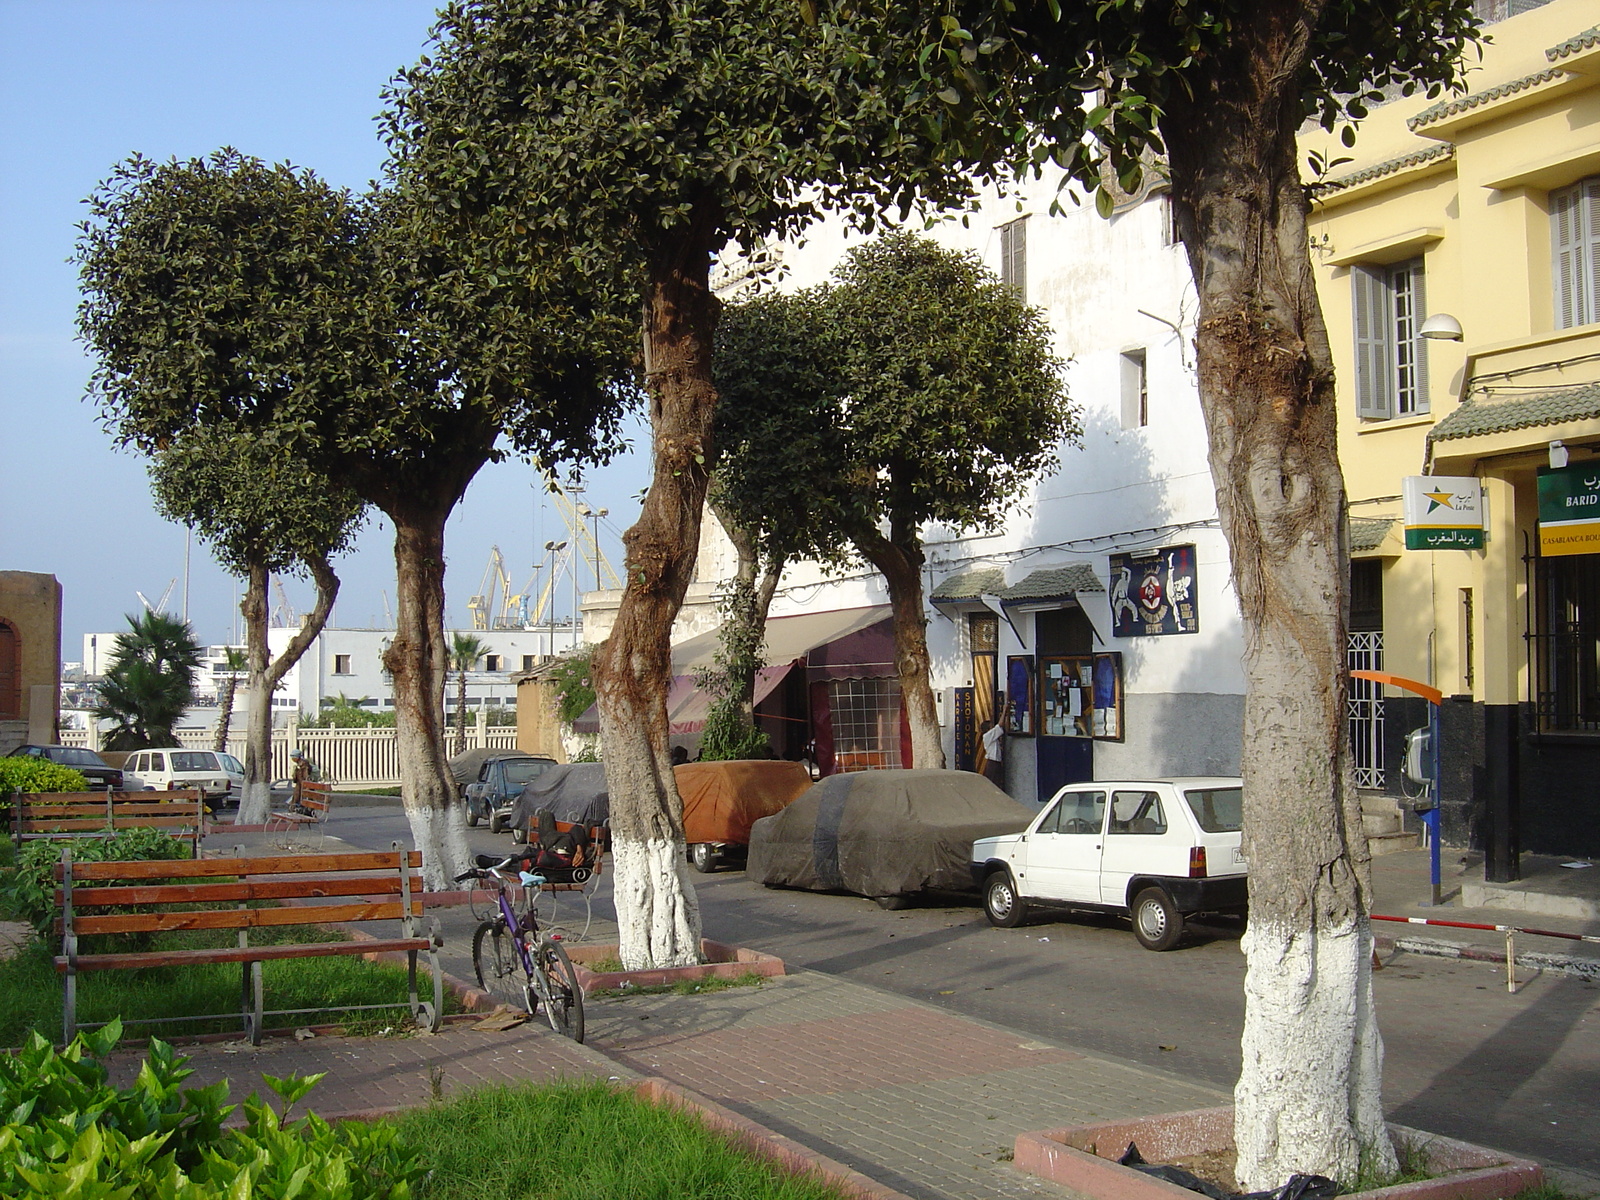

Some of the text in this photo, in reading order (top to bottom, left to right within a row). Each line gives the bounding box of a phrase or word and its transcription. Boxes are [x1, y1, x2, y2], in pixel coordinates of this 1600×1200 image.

[1566, 494, 1598, 507] BARID
[1427, 531, 1474, 545] بريد المغرب
[1542, 534, 1600, 545] CASABLANCA BOU
[964, 692, 972, 755] SHOTOKAN
